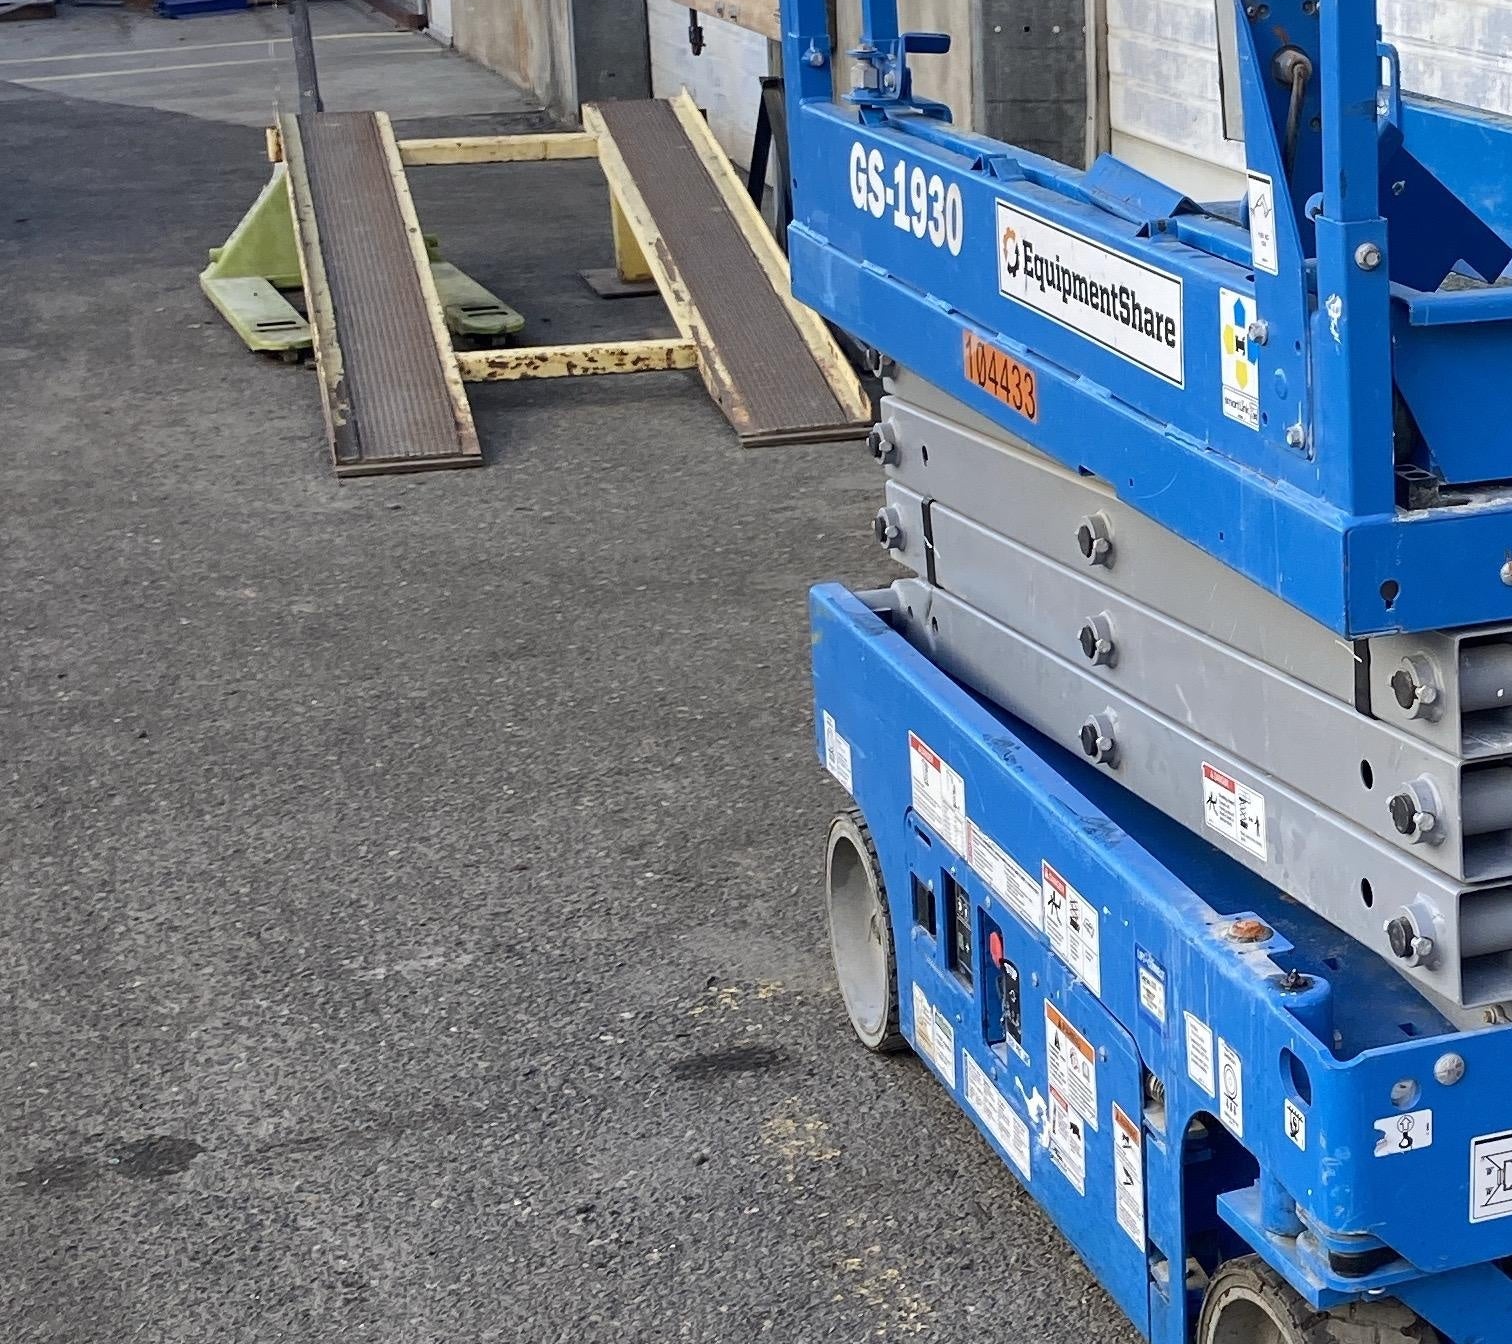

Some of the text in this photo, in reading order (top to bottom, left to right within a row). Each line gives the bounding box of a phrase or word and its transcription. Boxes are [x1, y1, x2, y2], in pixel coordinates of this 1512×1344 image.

[850, 141, 963, 257] GS-1930
[1022, 239, 1176, 349] EquipmentShare
[965, 334, 1036, 420] 104433
